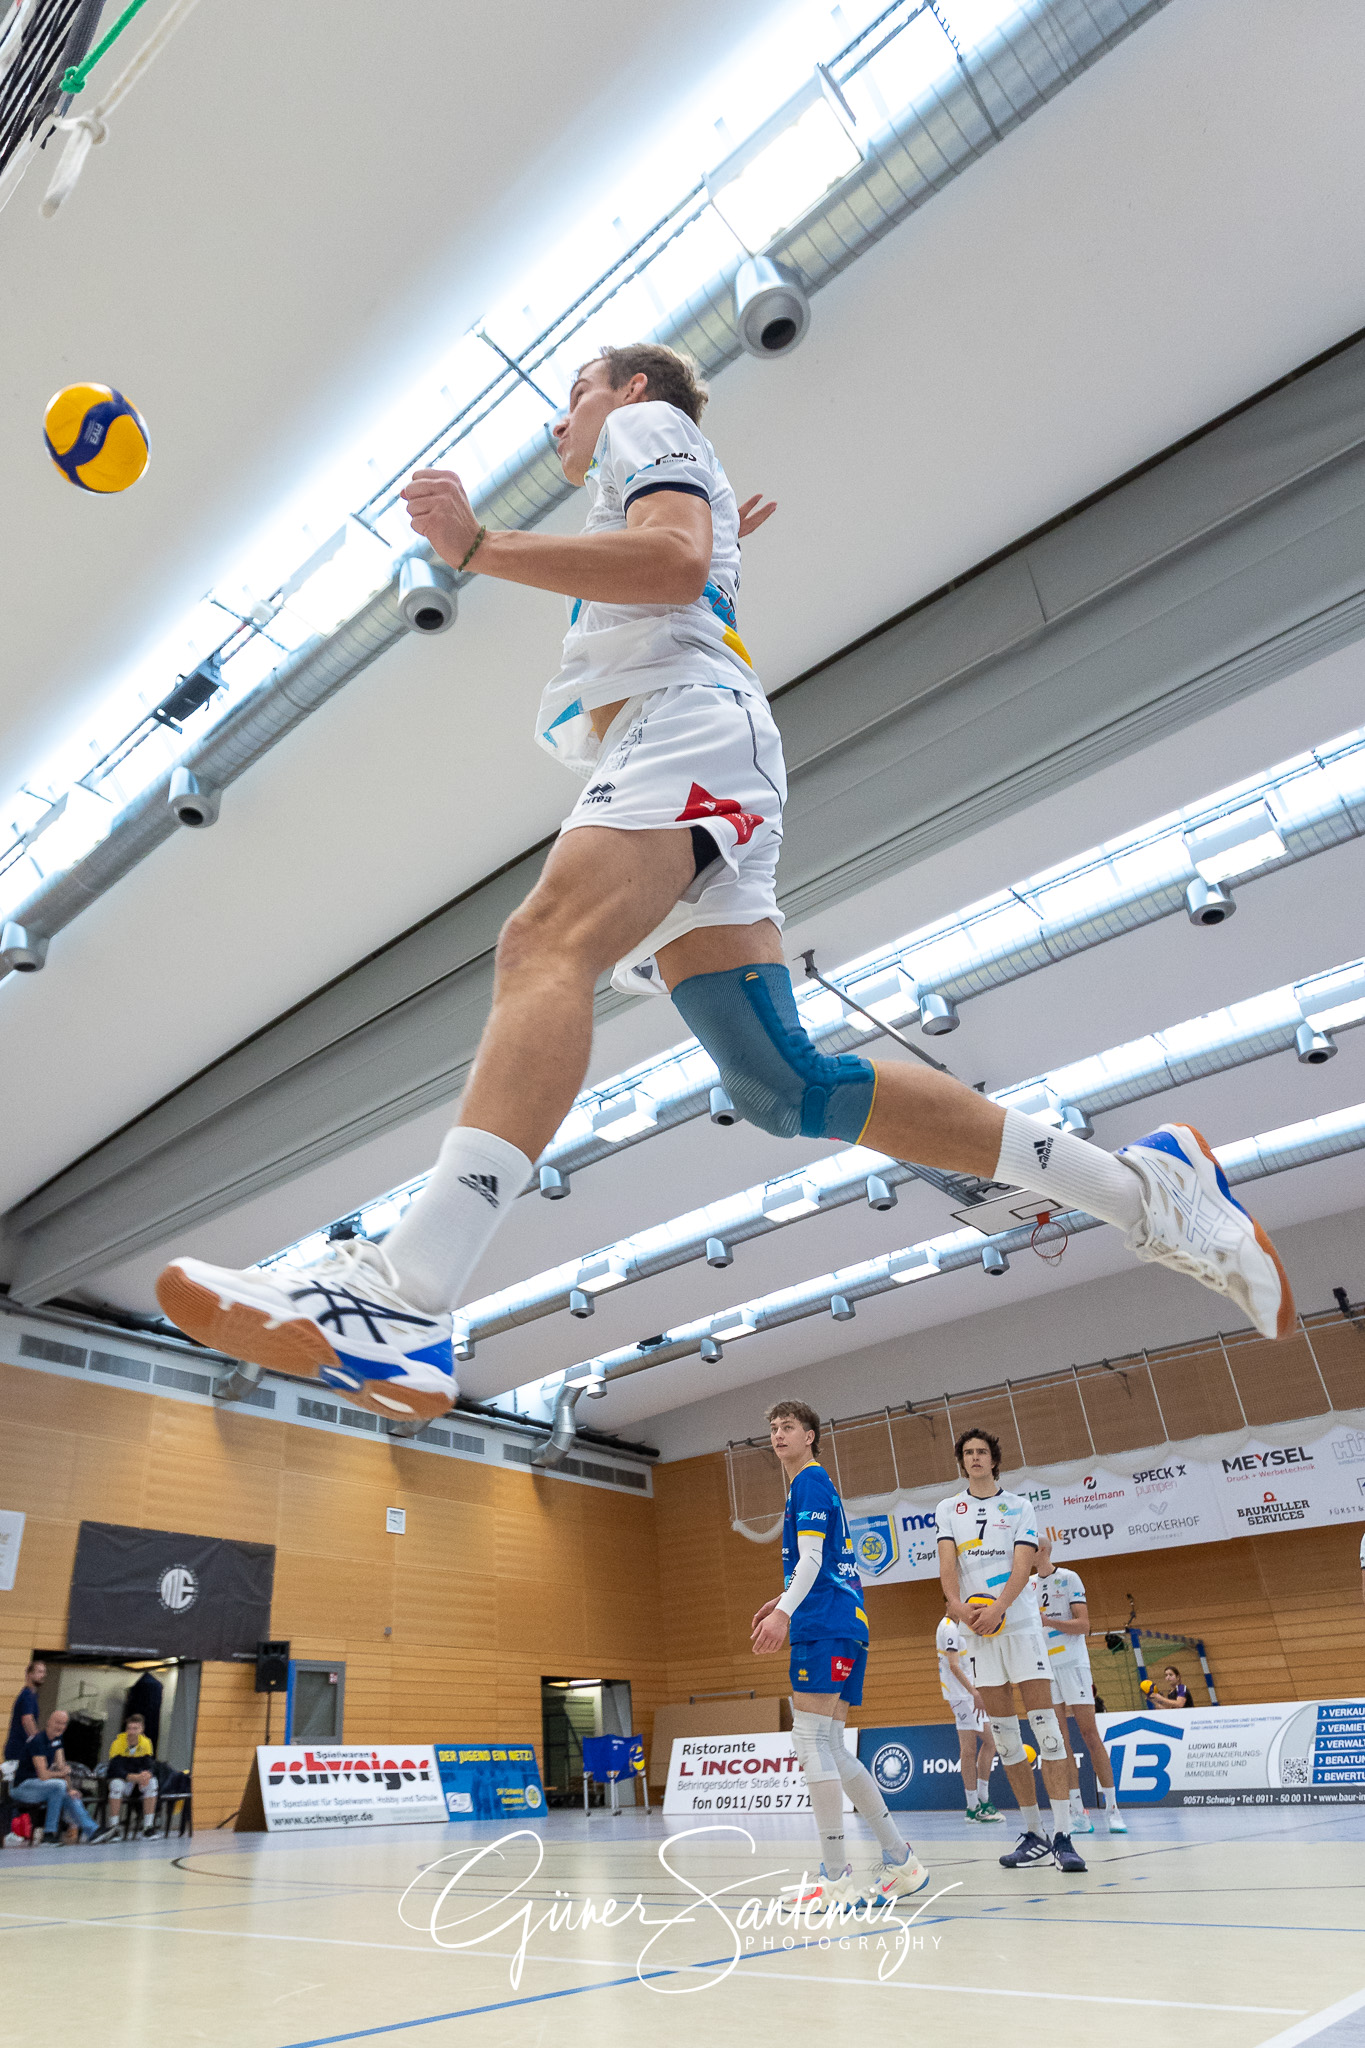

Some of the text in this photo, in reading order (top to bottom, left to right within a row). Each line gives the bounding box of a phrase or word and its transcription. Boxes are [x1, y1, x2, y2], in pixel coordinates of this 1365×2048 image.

[1041, 1137, 1054, 1169] adidas
[1221, 1446, 1314, 1474] MEYSEL
[1132, 1466, 1174, 1484] SPECK
[1226, 1473, 1250, 1483] Druck
[1258, 1463, 1316, 1479] Werbetechnik
[1136, 1480, 1178, 1496] pumpen
[1063, 1489, 1125, 1505] Heinzelmann
[1084, 1502, 1107, 1511] Medien
[811, 1511, 827, 1521] puls
[1247, 1510, 1305, 1525] SERVICES
[976, 1519, 988, 1540] 7
[1128, 1516, 1200, 1536] BROCKERHOF
[916, 1550, 936, 1561] Zapf
[1042, 1592, 1050, 1607] 2
[315, 1751, 370, 1759] Spielwaren
[439, 1750, 457, 1762] DER
[682, 1741, 756, 1756] Ristorante
[1187, 1750, 1262, 1759] BAUFINANZIERUNGS-
[269, 1752, 430, 1790] schweiger
[1186, 1759, 1247, 1769] BETREUUNG UND
[677, 1778, 748, 1792] Behringersdorfer
[750, 1777, 779, 1788] Straße
[783, 1777, 789, 1787] 6
[800, 1776, 808, 1787] S
[416, 1794, 438, 1802] Schule
[692, 1794, 812, 1811] fon 0911/50 57 71
[1183, 1794, 1204, 1805] 90571
[1206, 1793, 1236, 1805] Schwaig
[1255, 1793, 1274, 1803] 0911
[1280, 1794, 1290, 1803] 50
[1291, 1794, 1301, 1802] 00
[1303, 1794, 1311, 1802] 11
[272, 1811, 374, 1826] www.schweiger.de
